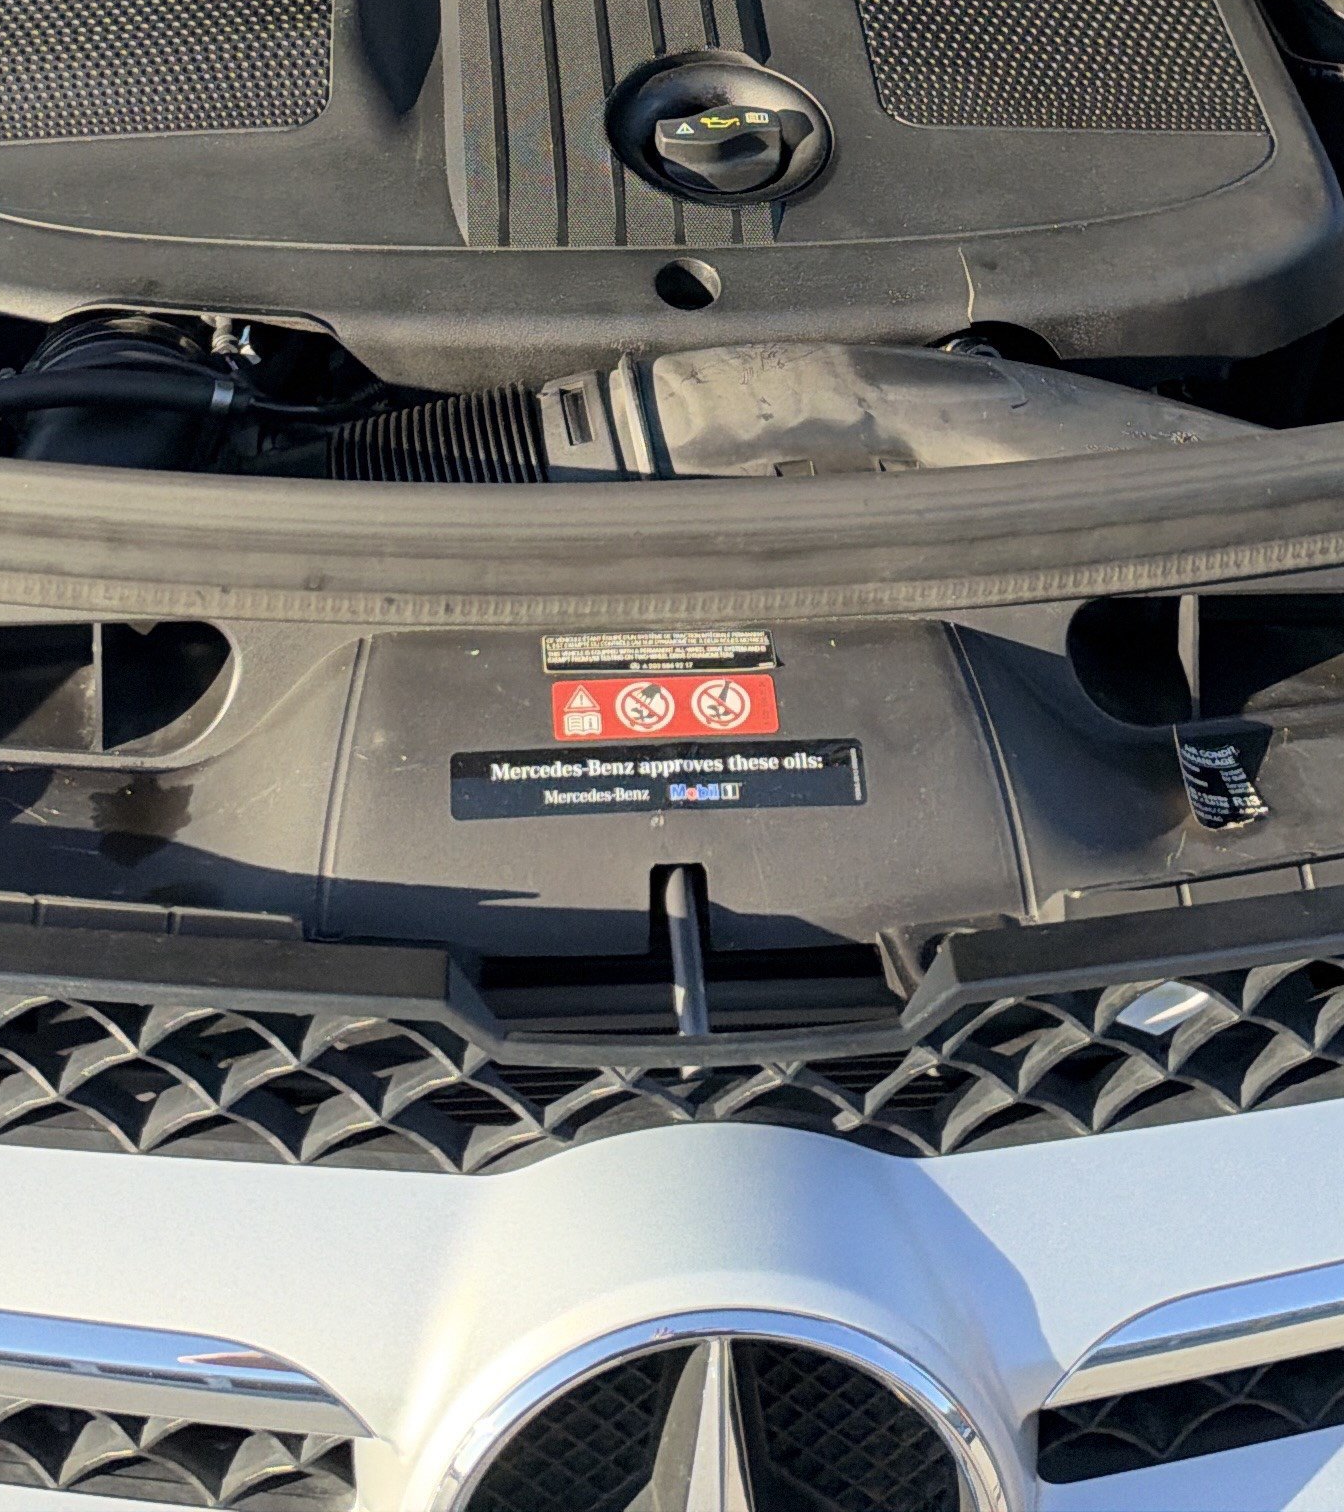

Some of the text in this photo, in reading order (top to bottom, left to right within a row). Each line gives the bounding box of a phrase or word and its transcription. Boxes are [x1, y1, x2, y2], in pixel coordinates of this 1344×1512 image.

[490, 751, 824, 781] Mercedes-Benz approves these oils:
[544, 787, 650, 804] Mercedes-Benz
[670, 784, 720, 801] Mobil
